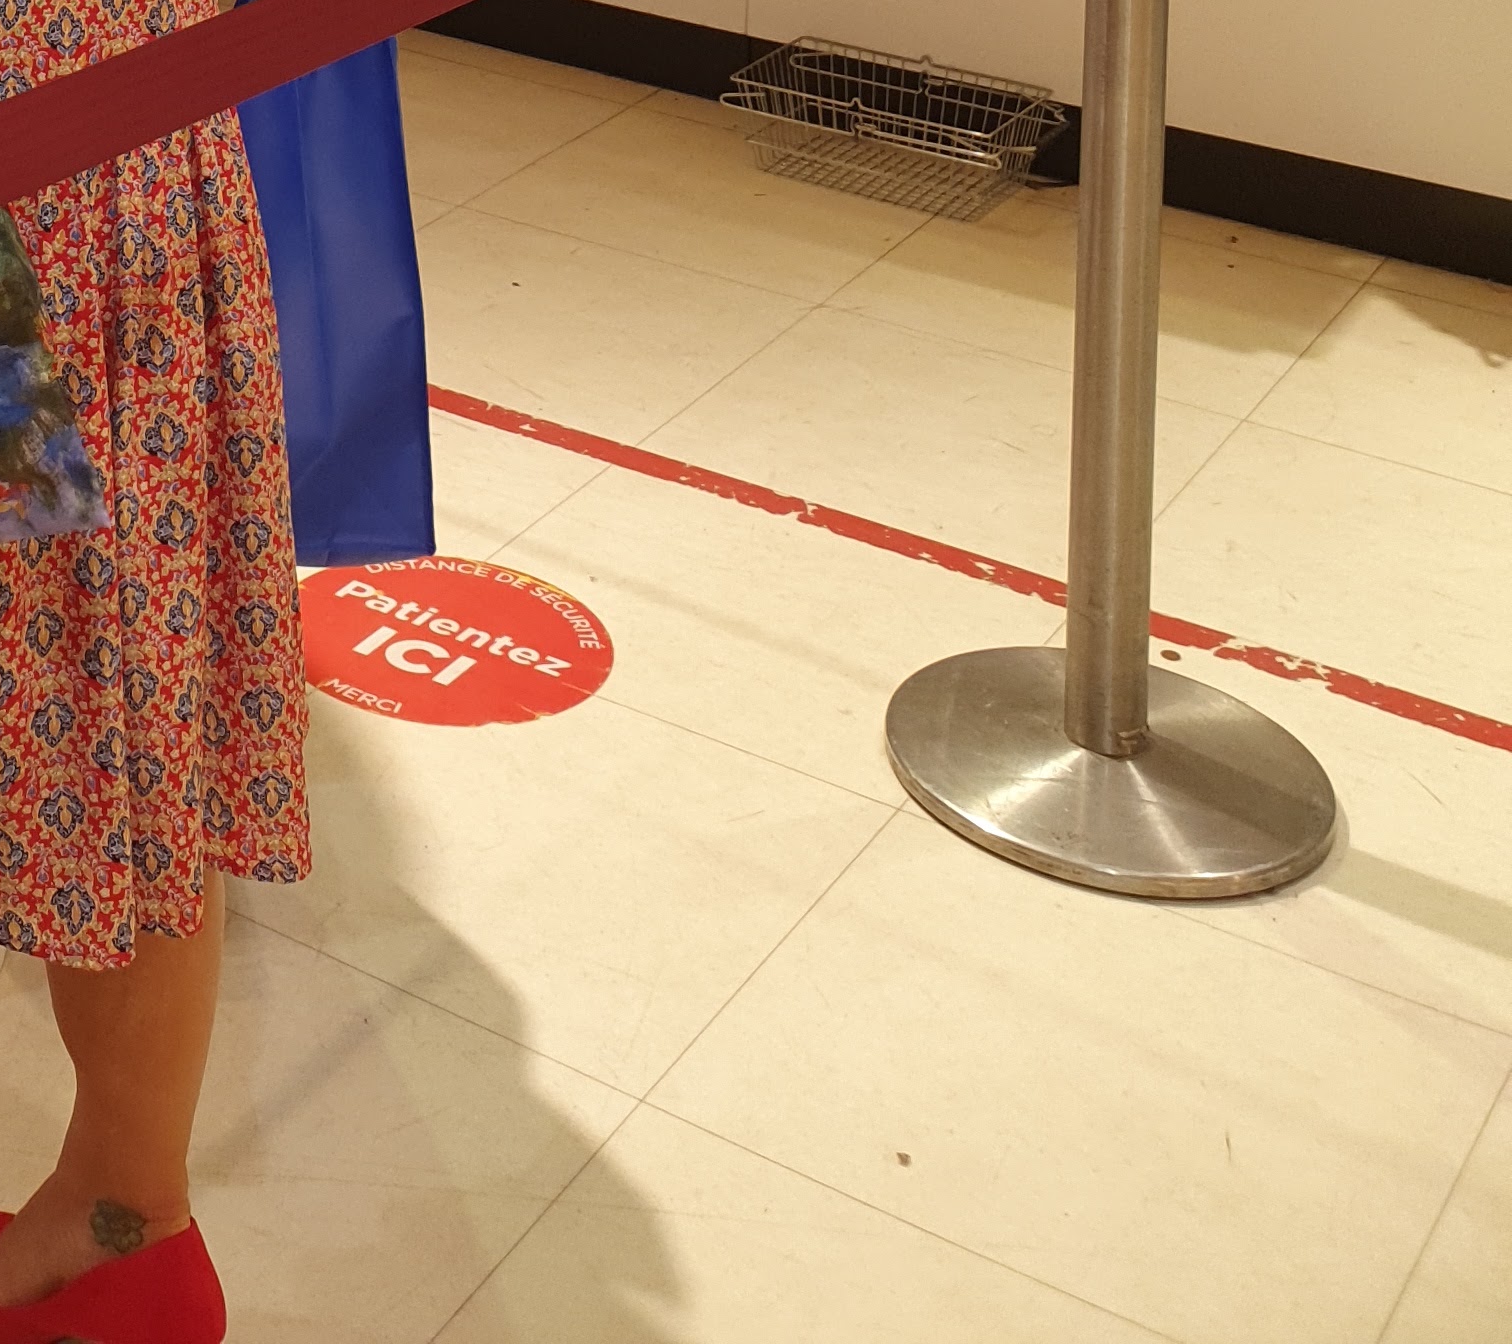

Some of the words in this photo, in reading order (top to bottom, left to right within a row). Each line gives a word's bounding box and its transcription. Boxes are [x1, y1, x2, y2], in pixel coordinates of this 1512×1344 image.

[364, 558, 492, 578] DISTANCE
[493, 571, 528, 591] DE
[334, 579, 573, 678] Patientez
[351, 625, 478, 687] ICI
[325, 677, 403, 714] MERCI
